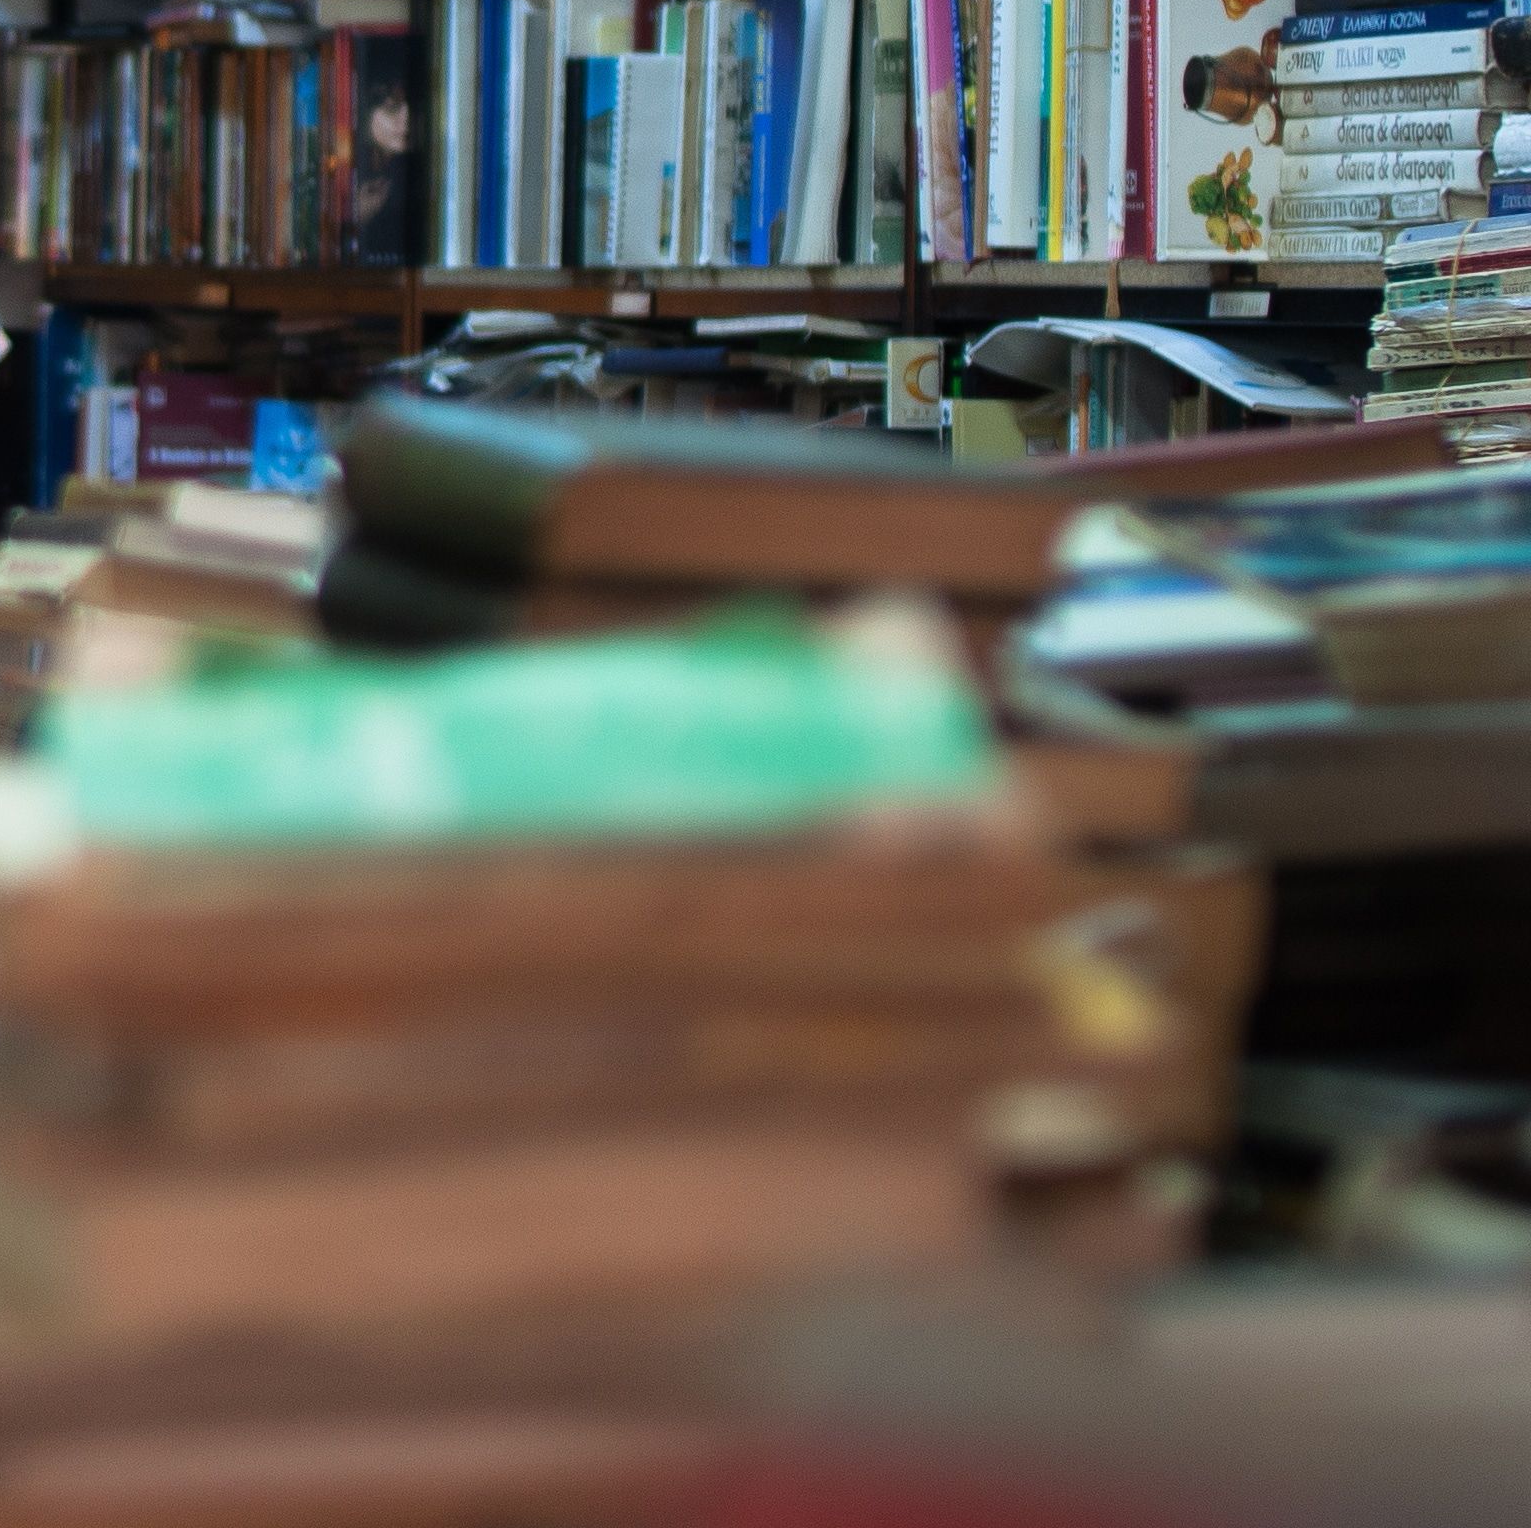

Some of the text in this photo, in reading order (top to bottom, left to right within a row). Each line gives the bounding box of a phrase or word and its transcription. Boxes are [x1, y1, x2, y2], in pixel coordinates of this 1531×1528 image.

[1337, 115, 1375, 143] δίαιτα
[1377, 115, 1389, 142] &
[1390, 113, 1454, 146] διατροφή
[1336, 153, 1375, 181] δίαιτα
[1377, 154, 1389, 180] &
[1391, 151, 1456, 185] διατροφή
